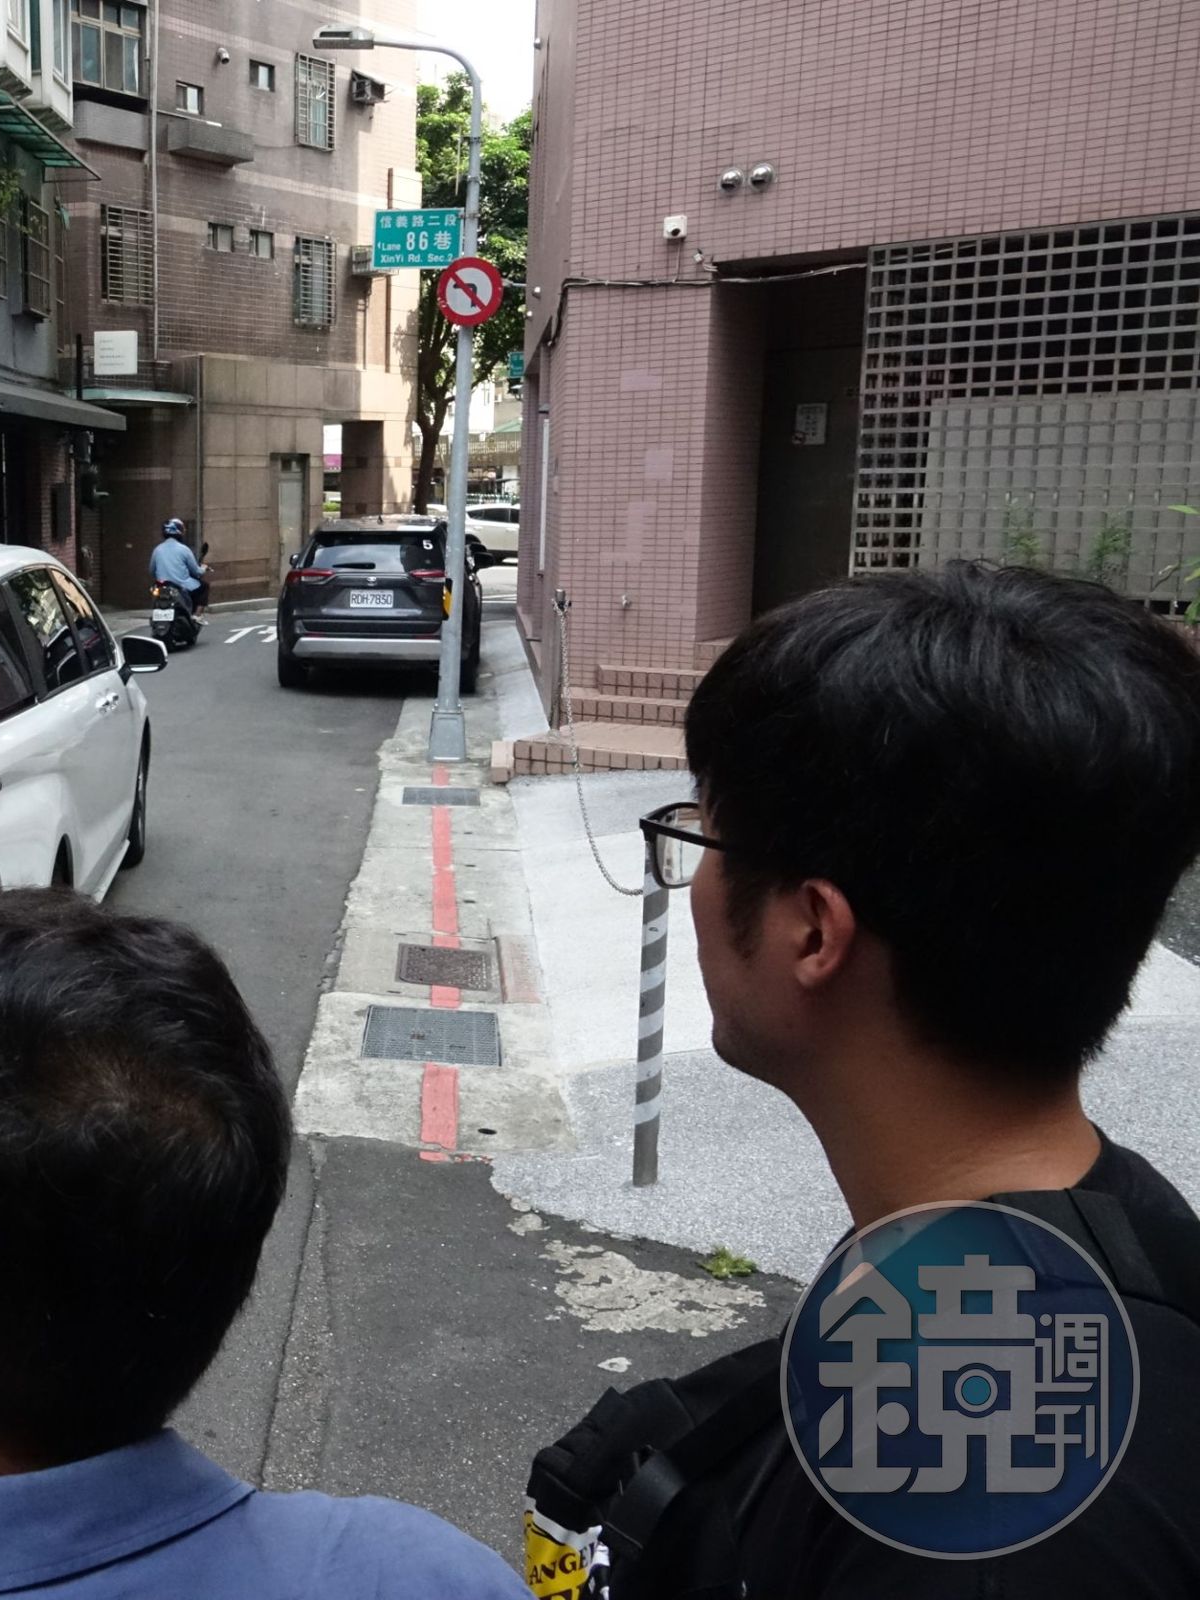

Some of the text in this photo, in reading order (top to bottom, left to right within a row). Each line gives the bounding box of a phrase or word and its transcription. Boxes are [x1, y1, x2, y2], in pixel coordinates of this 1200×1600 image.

[380, 214, 457, 229] 信義路二段
[382, 242, 401, 251] Lane
[380, 254, 404, 264] XinYi
[408, 253, 423, 263] Rd.
[422, 539, 434, 551] 5
